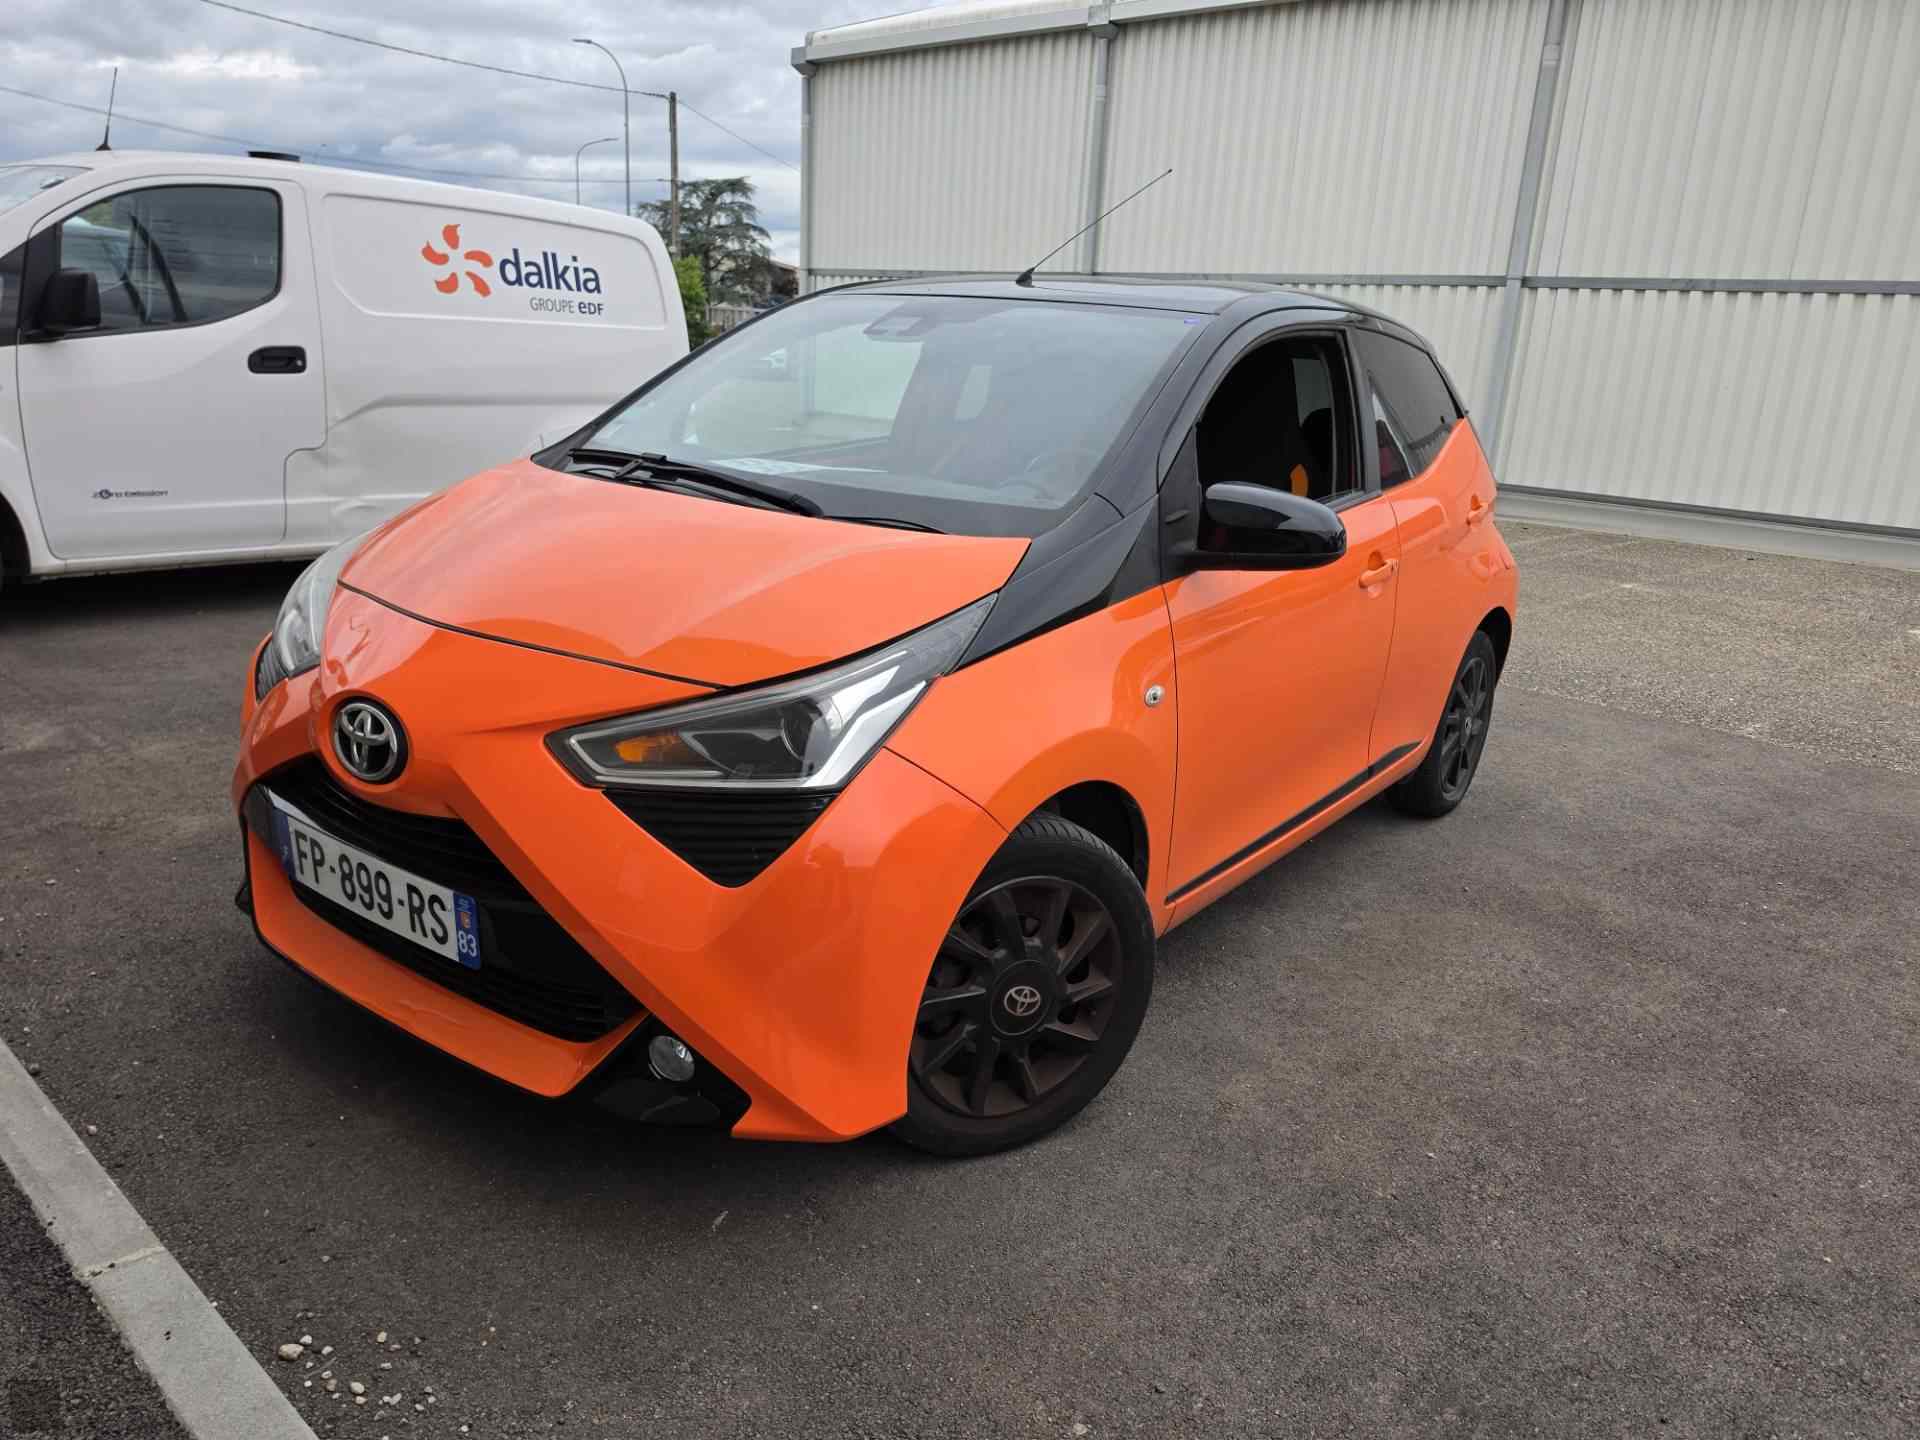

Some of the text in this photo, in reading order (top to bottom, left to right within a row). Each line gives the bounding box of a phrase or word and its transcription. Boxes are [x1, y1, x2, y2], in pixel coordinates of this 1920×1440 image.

[499, 248, 602, 294] dalkia
[529, 297, 575, 314] GROUPE
[294, 829, 450, 946] FP-899-RS
[458, 930, 477, 957] 83
